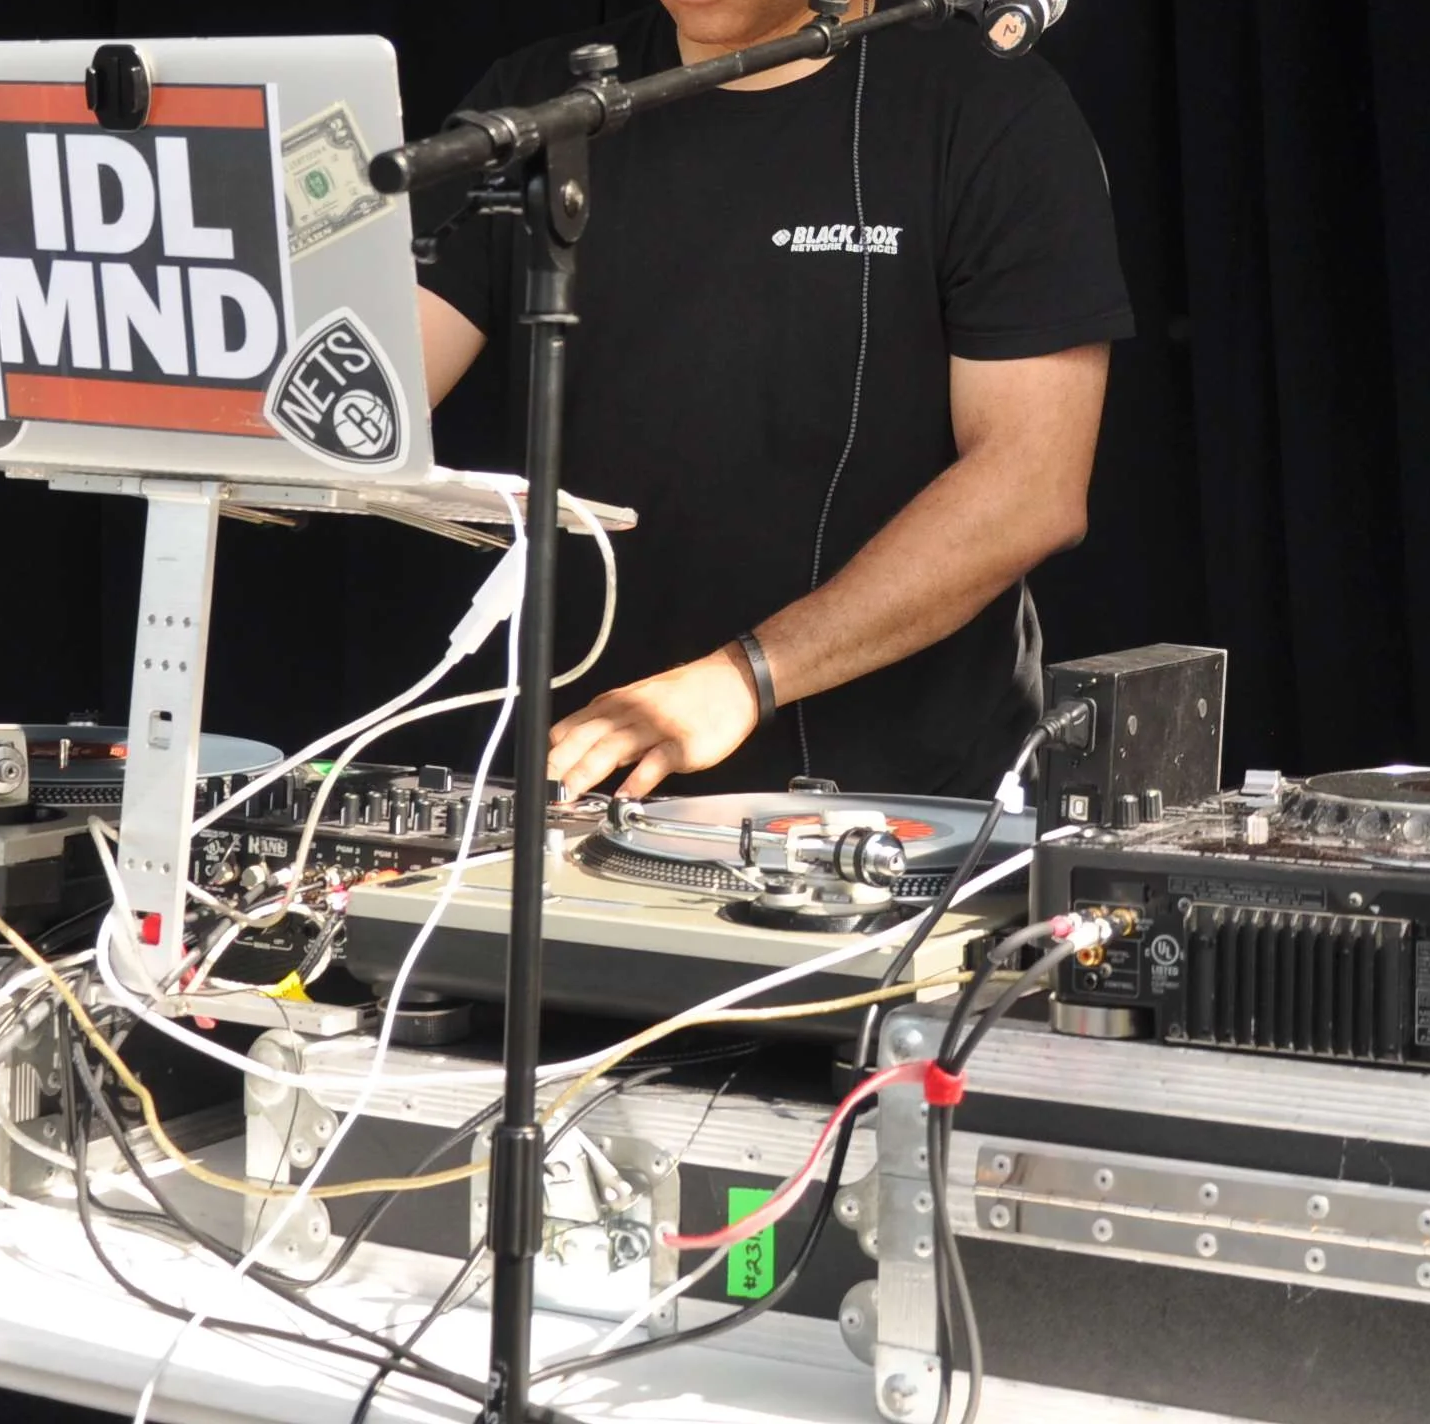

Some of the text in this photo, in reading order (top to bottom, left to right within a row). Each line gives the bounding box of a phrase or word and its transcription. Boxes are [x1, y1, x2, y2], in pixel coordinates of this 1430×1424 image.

[24, 131, 236, 260] IDL
[790, 242, 843, 253] NETWORK
[792, 223, 856, 245] BLACK
[281, 330, 372, 440] NETS
[742, 1228, 764, 1291] #231
